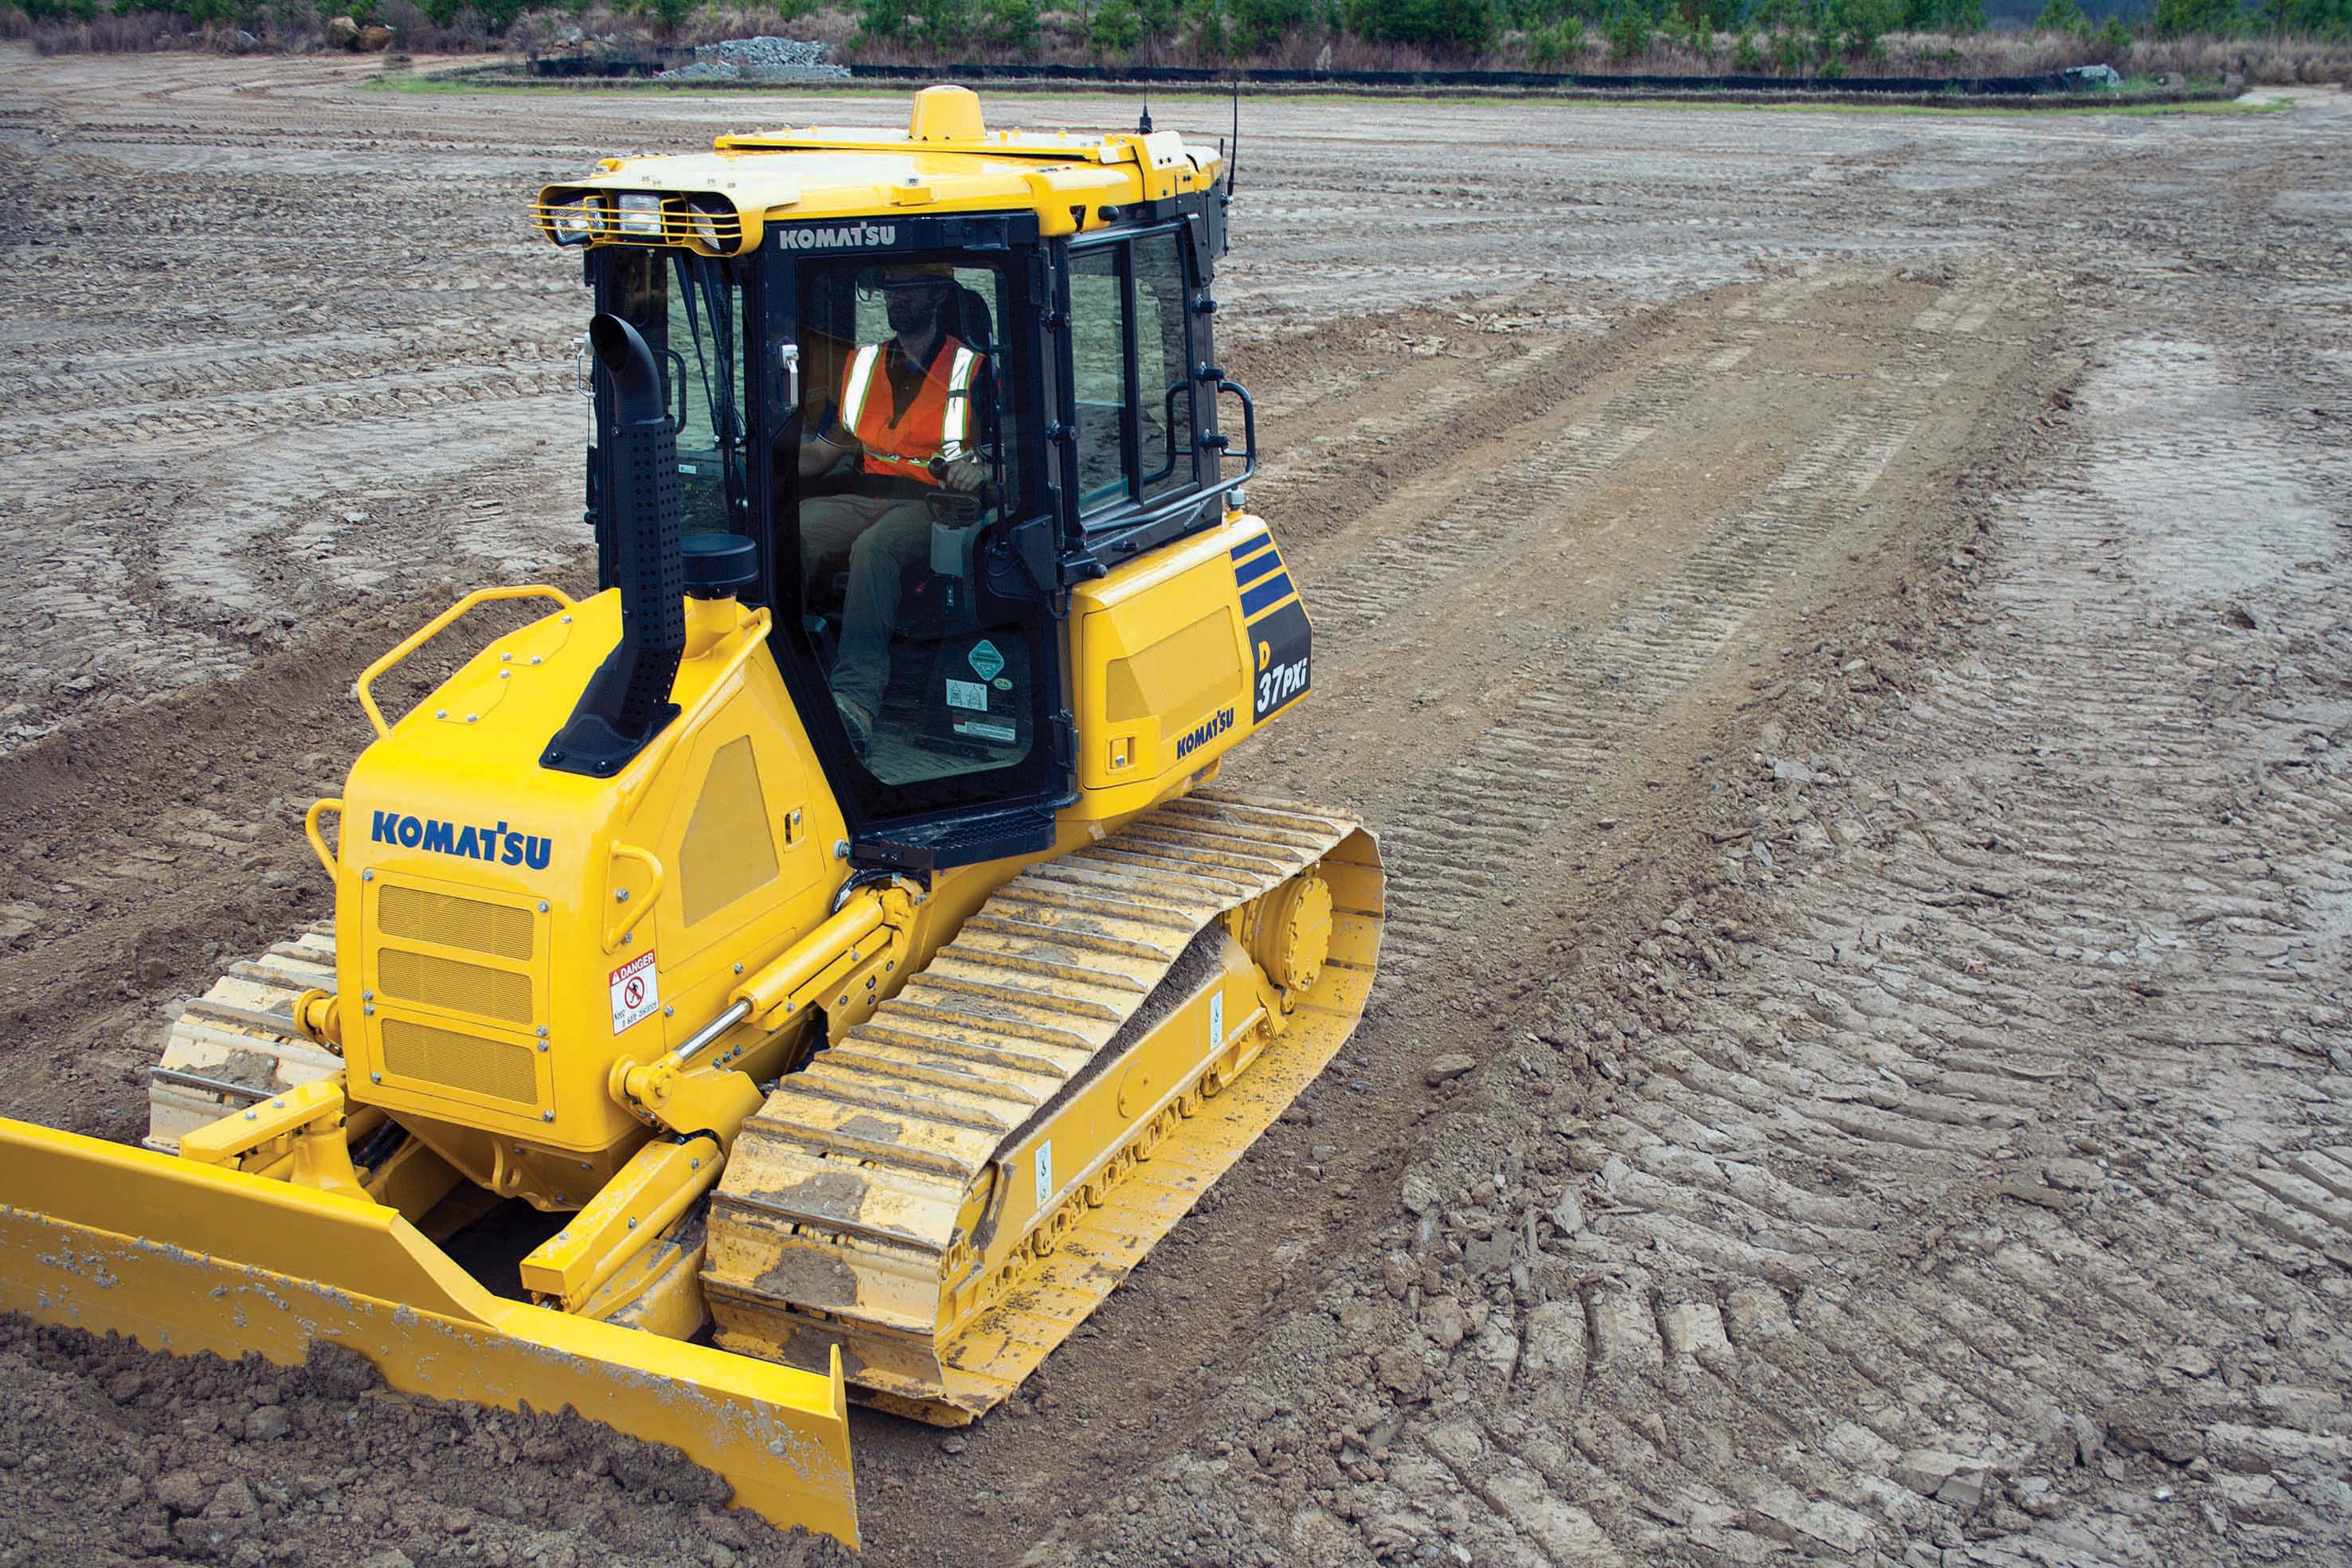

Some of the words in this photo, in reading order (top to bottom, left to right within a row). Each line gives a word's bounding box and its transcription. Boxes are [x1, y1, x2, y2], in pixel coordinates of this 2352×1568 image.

[779, 221, 896, 249] KOMATSU
[1258, 640, 1271, 672] D
[1257, 657, 1308, 714] 37PXi
[1176, 707, 1235, 760] KOMATSU
[371, 810, 552, 870] KOMATSU
[620, 952, 655, 980] DANGER
